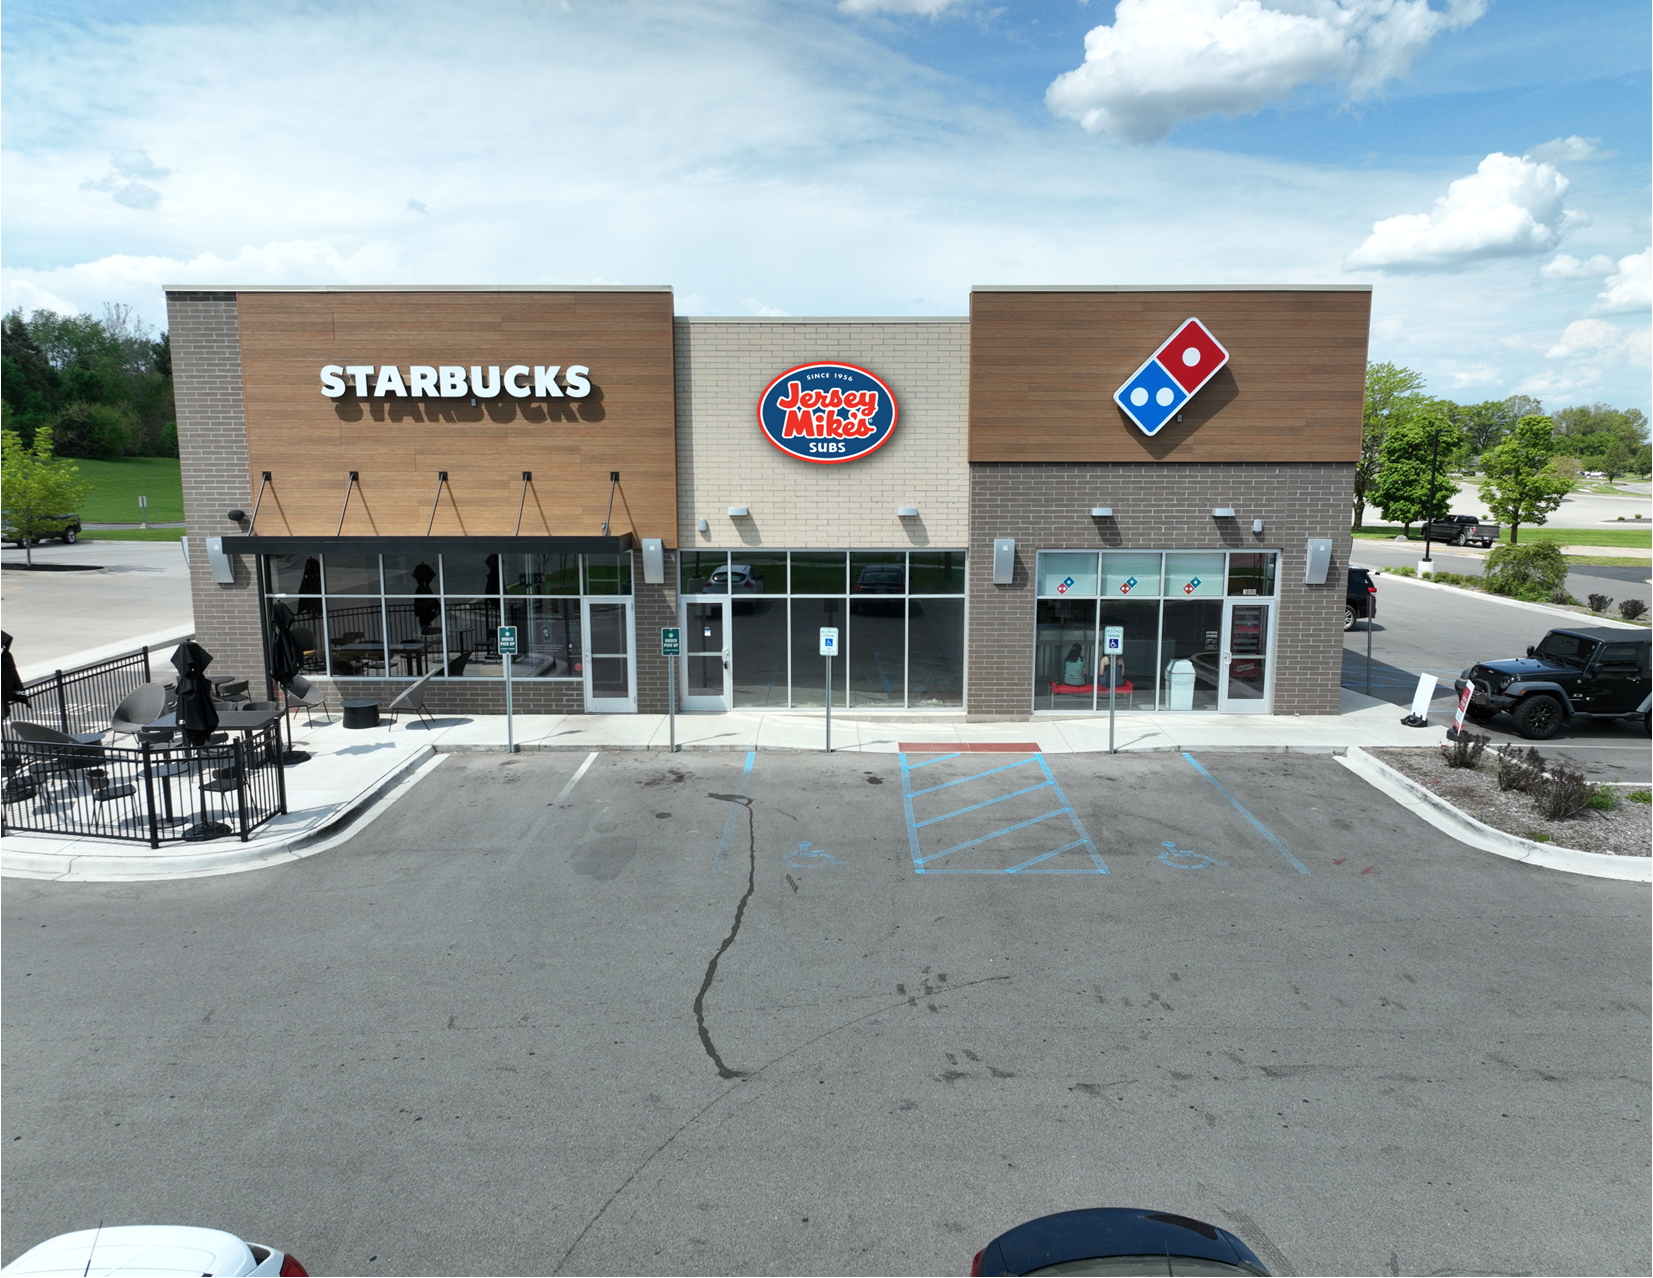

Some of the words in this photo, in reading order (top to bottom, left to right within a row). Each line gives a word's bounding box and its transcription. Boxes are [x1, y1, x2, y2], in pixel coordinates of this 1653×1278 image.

[320, 364, 591, 398] STARBUCKS
[806, 372, 830, 380] SINCE
[834, 373, 853, 381] 1956
[778, 381, 878, 418] Jersey
[783, 409, 876, 439] Mike's
[809, 442, 846, 453] SUBS
